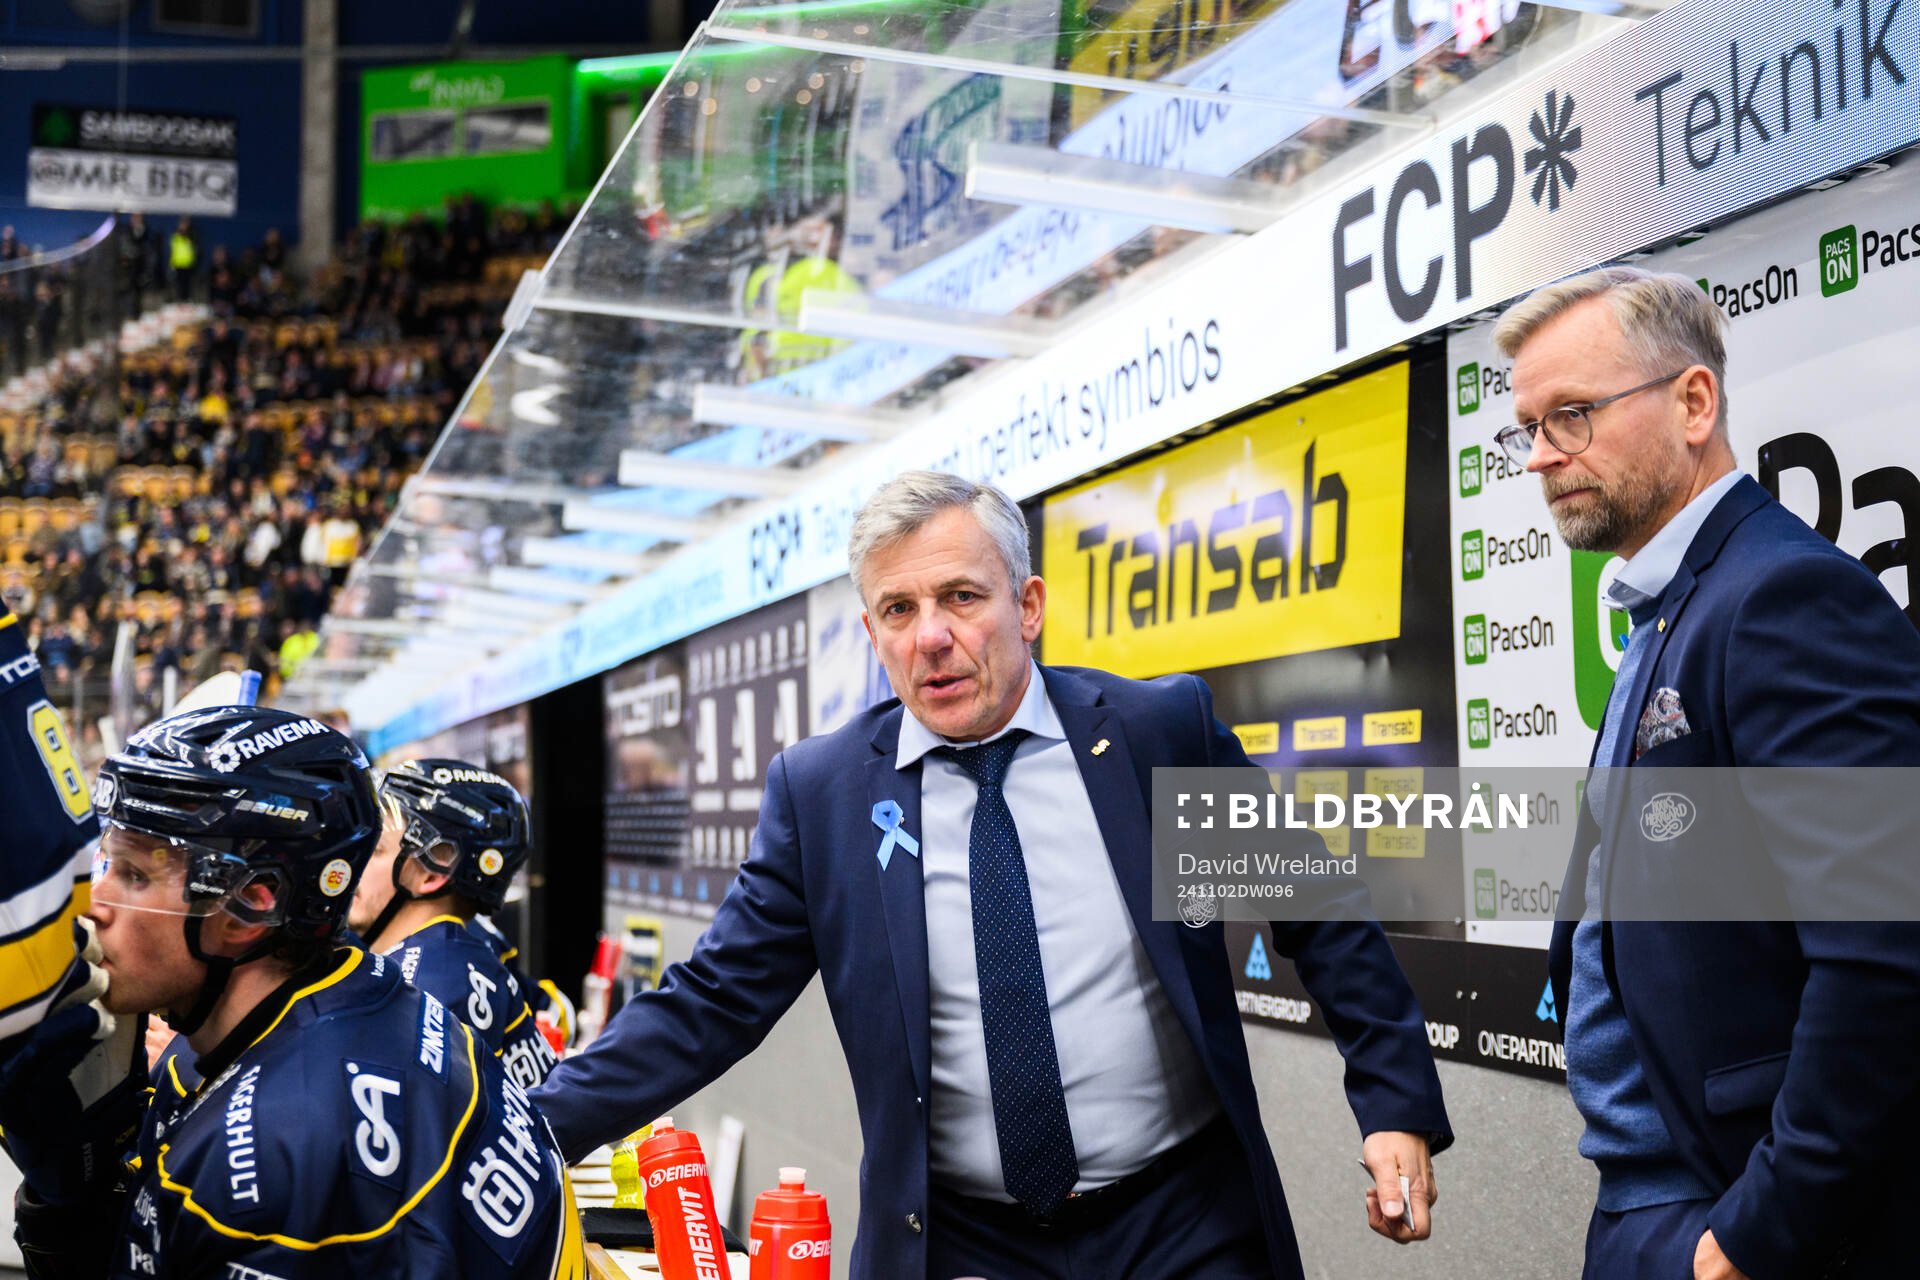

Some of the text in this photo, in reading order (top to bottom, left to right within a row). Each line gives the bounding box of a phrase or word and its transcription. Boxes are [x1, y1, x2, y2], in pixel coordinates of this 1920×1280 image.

[1333, 0, 1908, 354] FCP Teknik
[1825, 238, 1850, 259] PACS
[1826, 254, 1852, 285] ON
[1713, 265, 1798, 318] PacsOn
[979, 383, 1070, 483] perfekt
[1080, 317, 1221, 451] symbios
[1460, 384, 1477, 408] ON
[1462, 466, 1479, 490] ON
[1076, 435, 1349, 640] Transab
[1488, 528, 1551, 568] PacsOn
[1464, 552, 1482, 574] ON
[1466, 636, 1484, 657] ON
[1490, 616, 1554, 652] PacsOn
[1470, 720, 1488, 741] ON
[1493, 704, 1557, 738] PacsOn
[237, 719, 330, 760] RAVEMA
[27, 699, 96, 826] 8
[236, 800, 309, 821] BAUER
[190, 882, 226, 895] BAUER
[1501, 879, 1560, 914] PacsOn
[225, 1064, 262, 1203] FAGERHULT
[677, 1186, 721, 1280] ENERVIT
